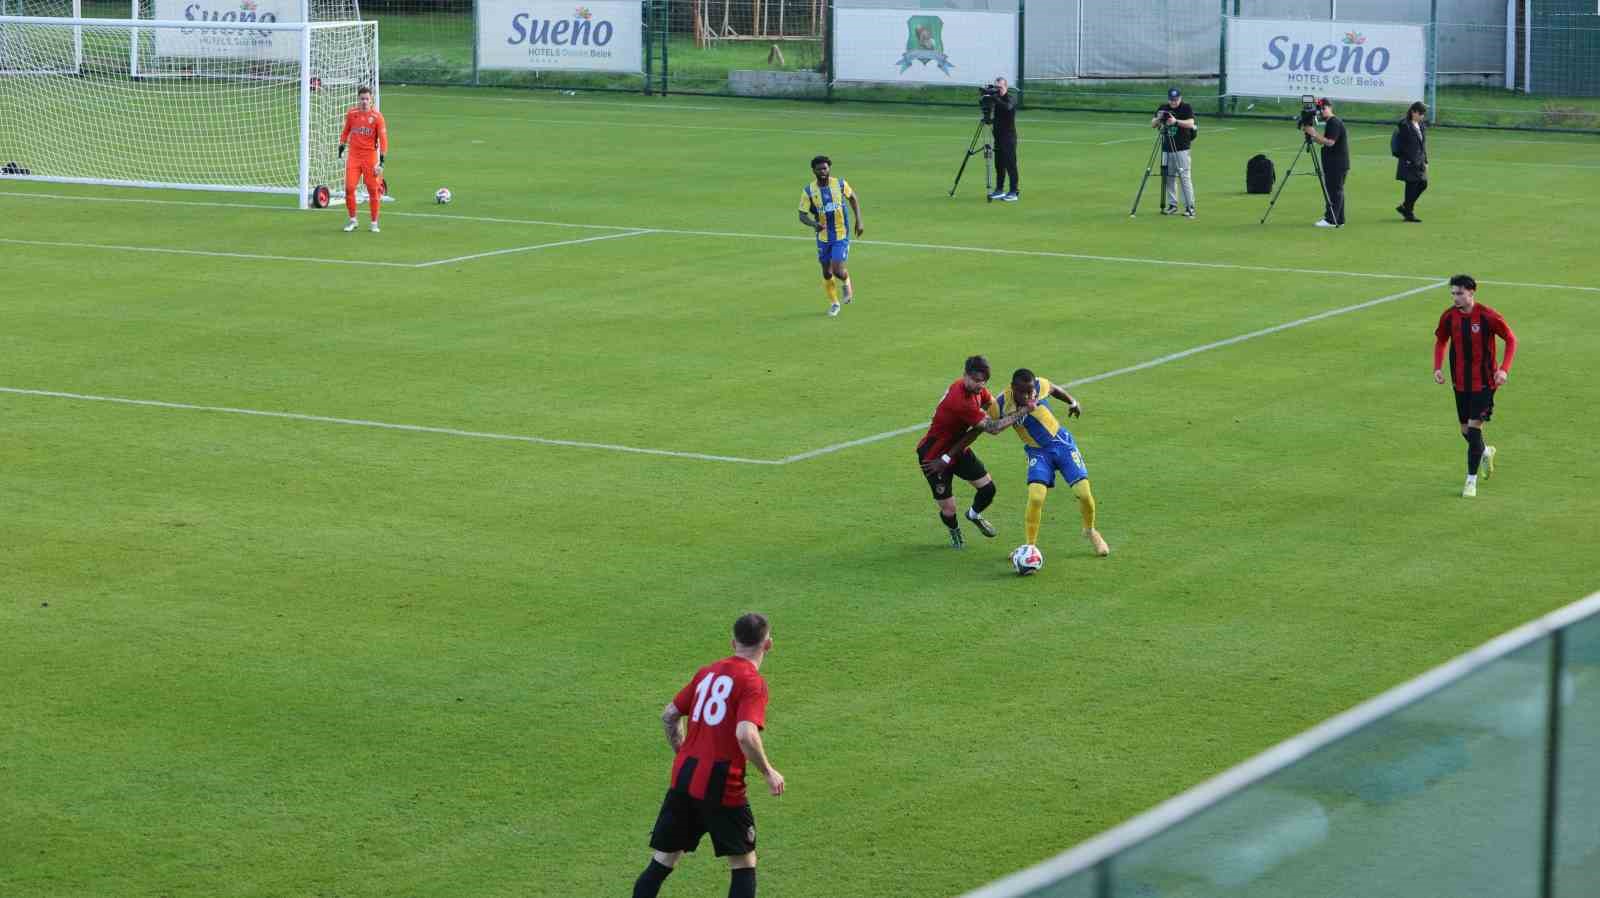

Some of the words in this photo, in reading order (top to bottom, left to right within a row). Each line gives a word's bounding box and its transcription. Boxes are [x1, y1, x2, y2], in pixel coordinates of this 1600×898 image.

[528, 47, 560, 57] HOTELS
[1288, 73, 1329, 85] HOTELS
[1332, 75, 1353, 86] Golf
[1356, 77, 1385, 88] Belek
[691, 671, 734, 726] 18
